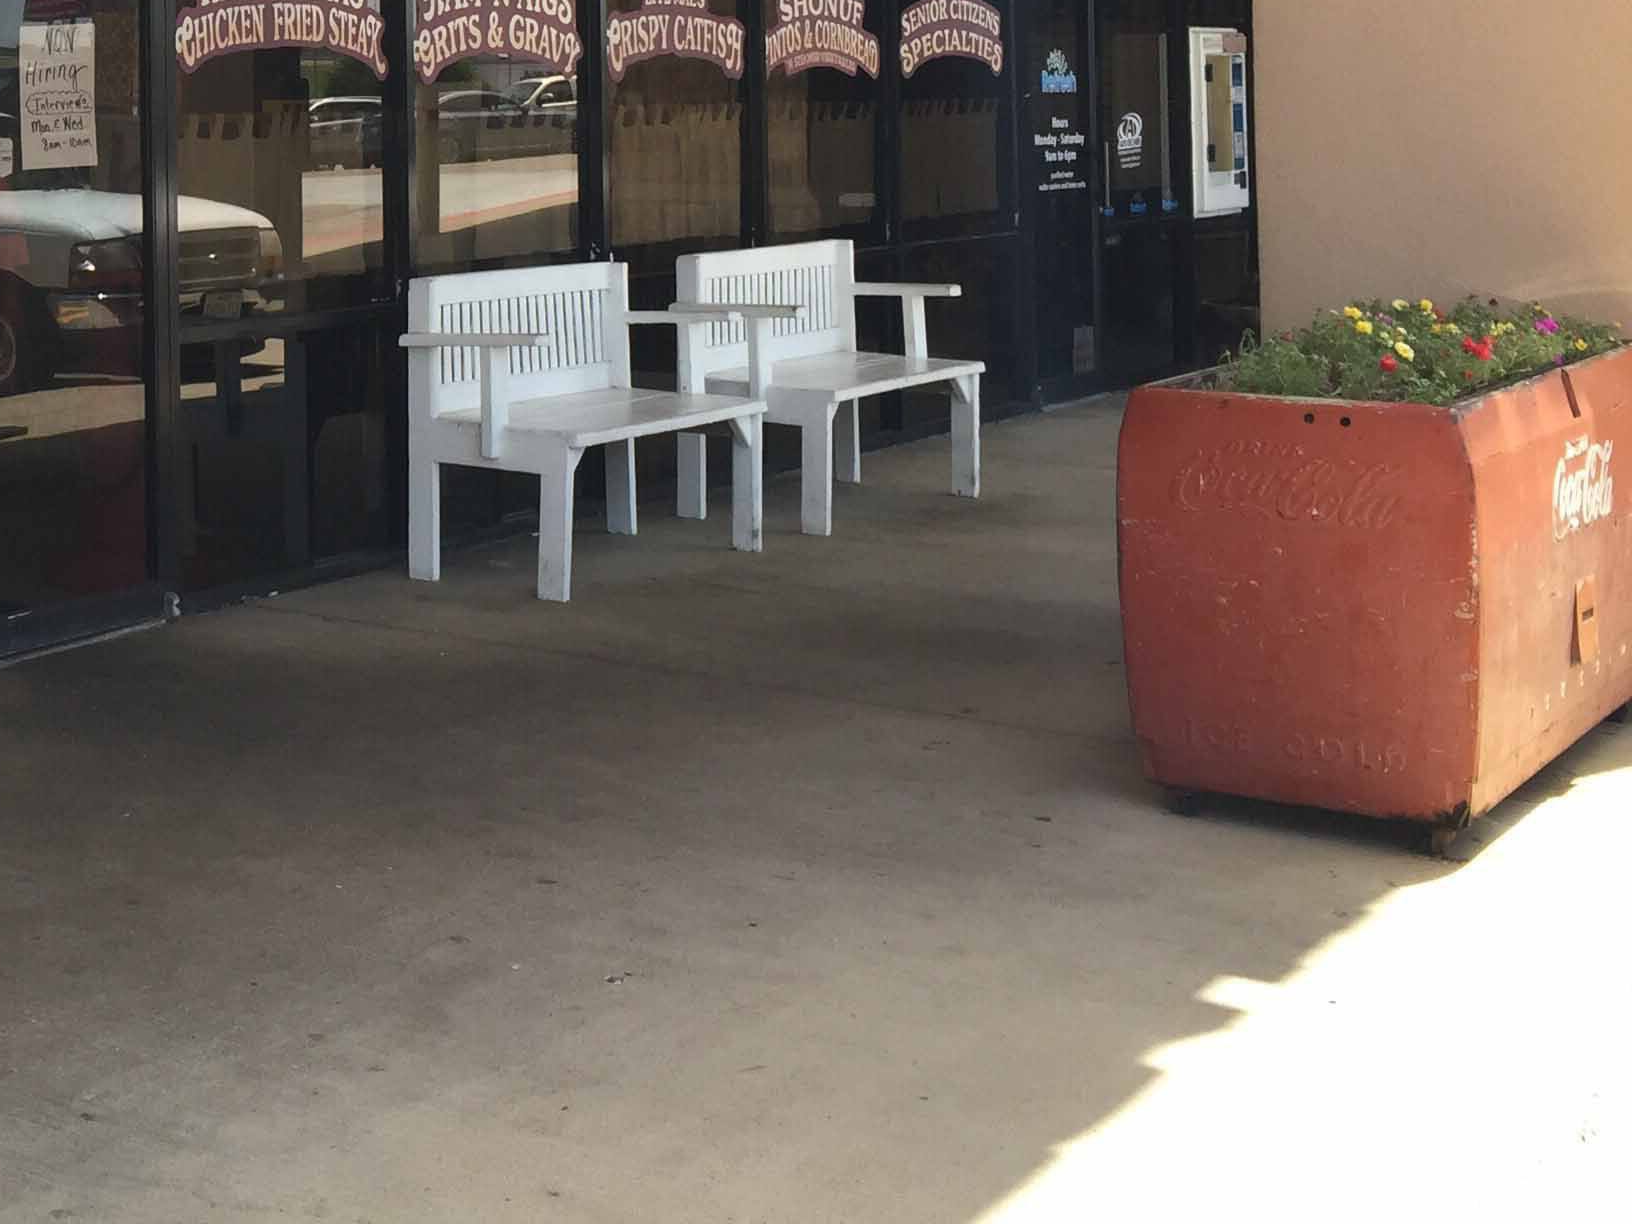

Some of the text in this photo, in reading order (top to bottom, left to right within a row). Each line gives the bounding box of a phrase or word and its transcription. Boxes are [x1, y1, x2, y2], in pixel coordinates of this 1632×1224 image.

[175, 2, 387, 75] CHICKEN FRIED STEAK
[413, 11, 581, 77] GRITS & GRAVY
[606, 14, 744, 73] CRISPY CATFISH
[766, 21, 802, 66] INTOS
[814, 19, 879, 75] CORNBREAD
[899, 27, 1004, 74] SPECIALTIES
[25, 59, 89, 93] Hiring
